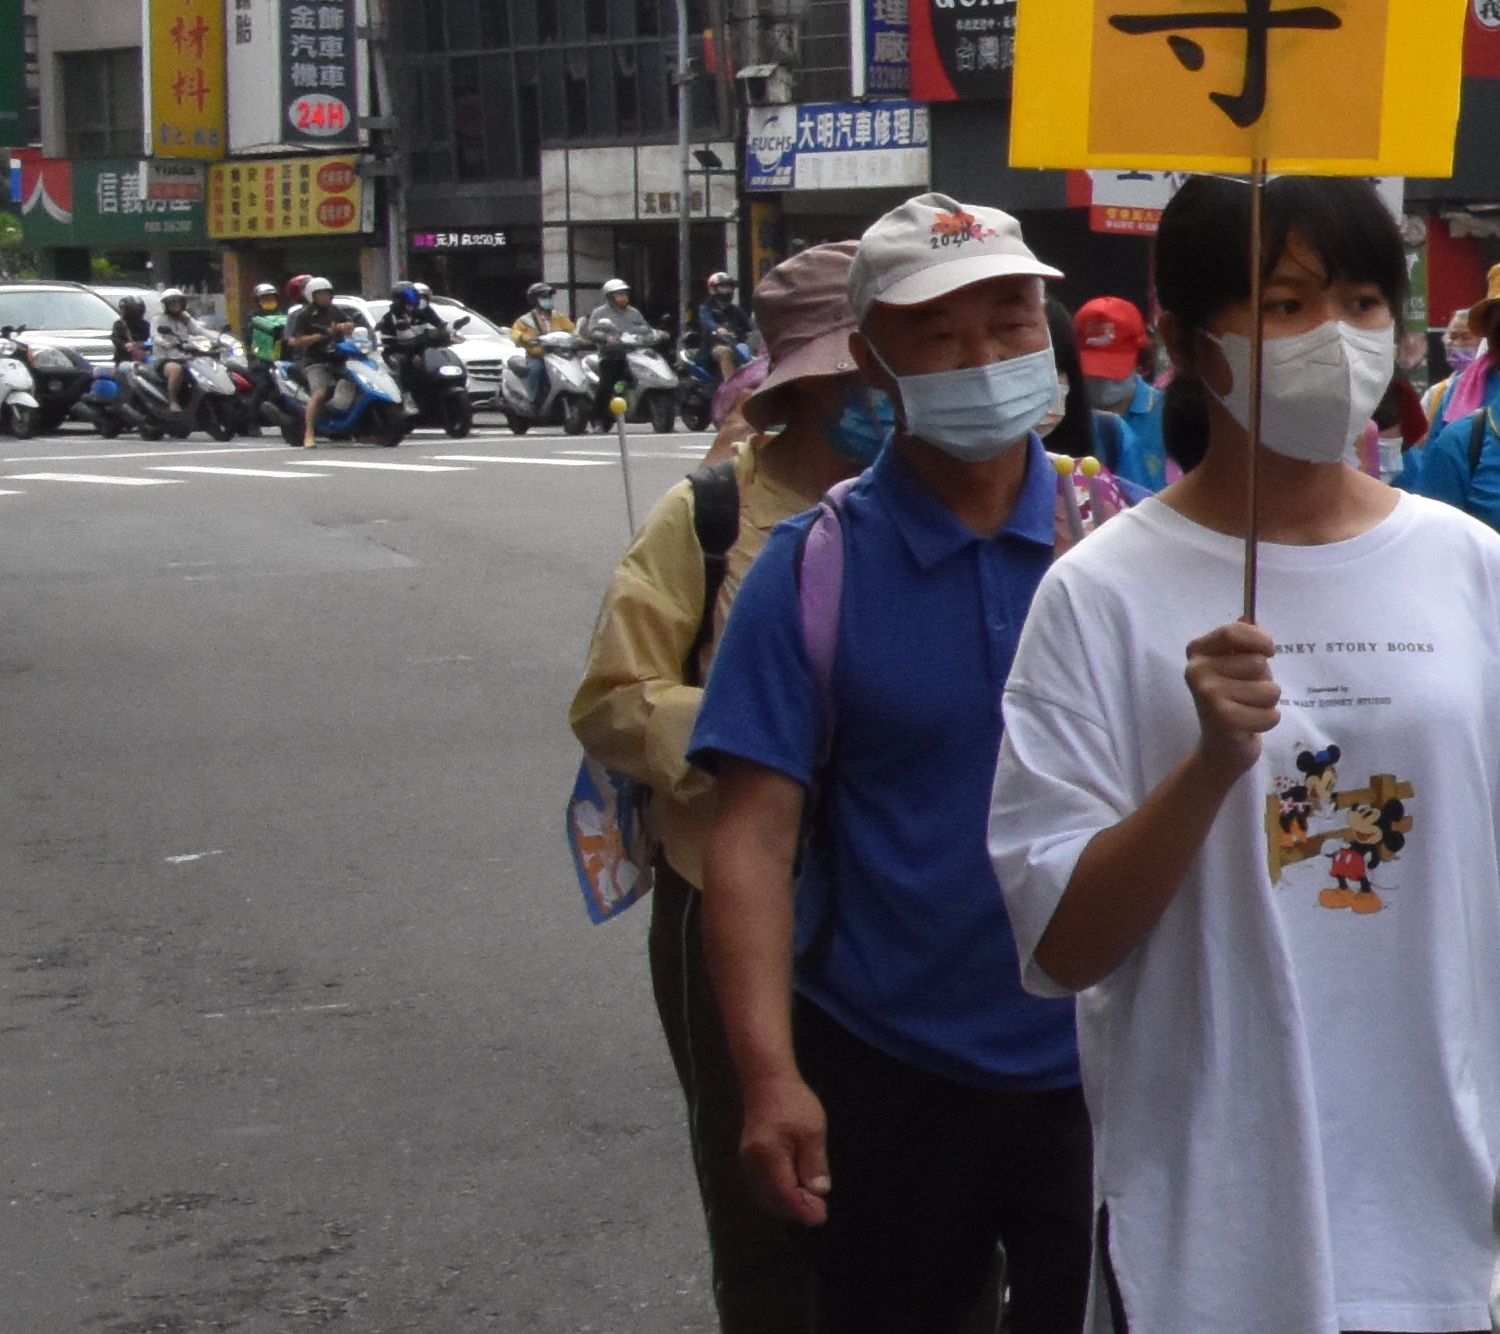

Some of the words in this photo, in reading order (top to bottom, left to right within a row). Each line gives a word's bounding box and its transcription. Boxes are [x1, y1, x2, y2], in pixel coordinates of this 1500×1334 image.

[296, 101, 345, 129] 24H
[930, 230, 971, 251] 2020
[1326, 642, 1378, 653] STORY
[1387, 642, 1435, 653] BOOKS
[1356, 697, 1392, 706] STUDIO
